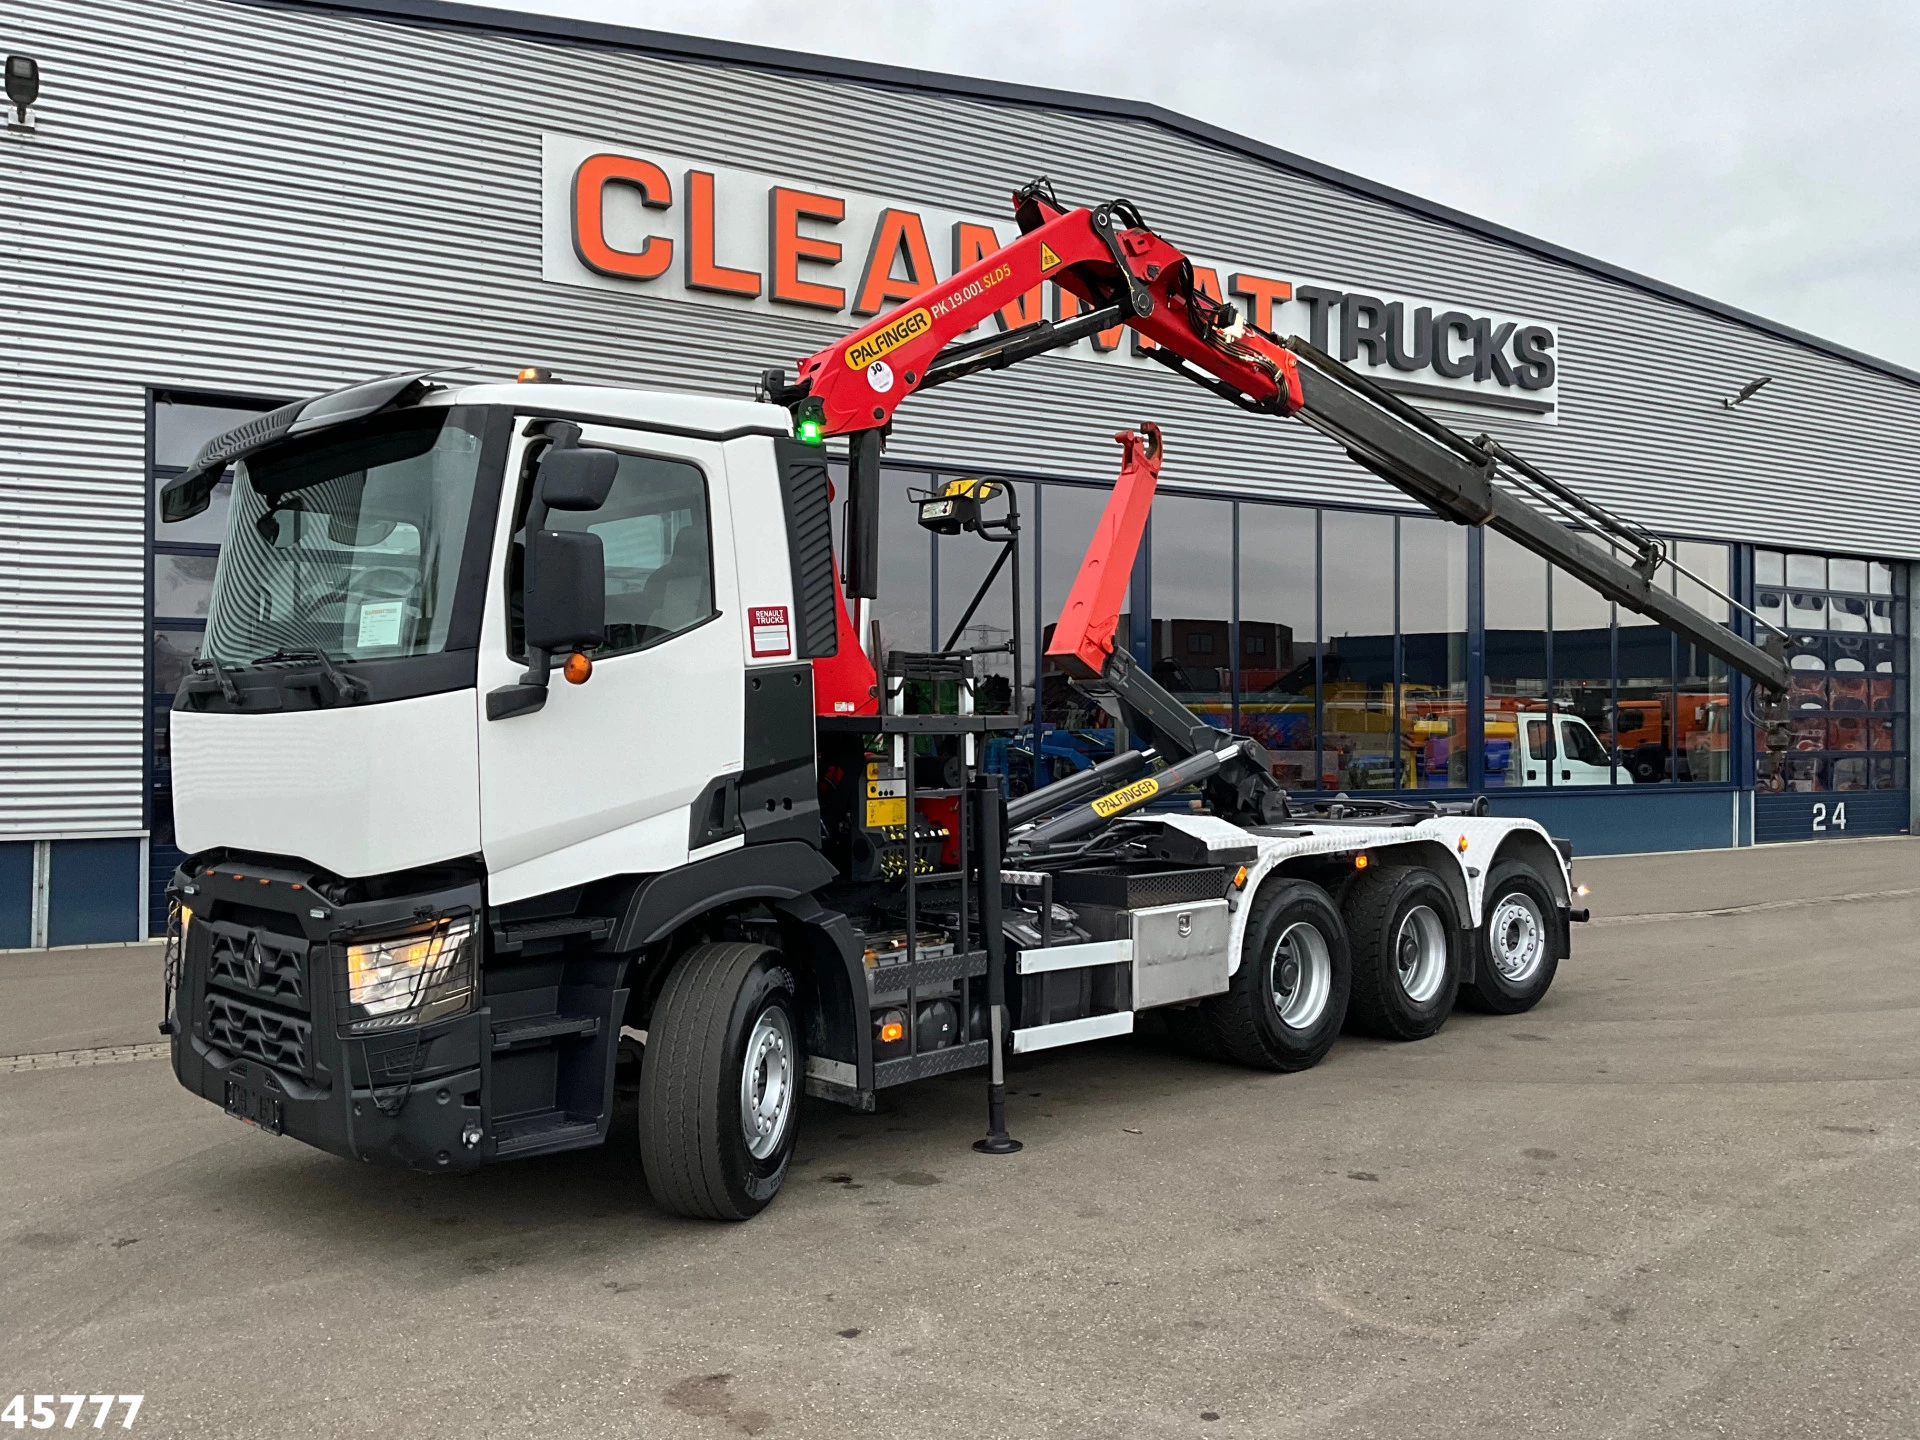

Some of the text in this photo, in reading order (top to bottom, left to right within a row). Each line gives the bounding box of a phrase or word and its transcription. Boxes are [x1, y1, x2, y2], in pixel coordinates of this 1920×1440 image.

[849, 312, 928, 366] PALFINGER
[930, 300, 949, 319] PK
[947, 280, 984, 310] 19.001
[1296, 285, 1555, 390] TRUCKS
[755, 609, 784, 617] RENAULT
[756, 616, 785, 625] TRUCKS
[1096, 780, 1156, 814] PALFINGER
[1812, 801, 1847, 832] 24
